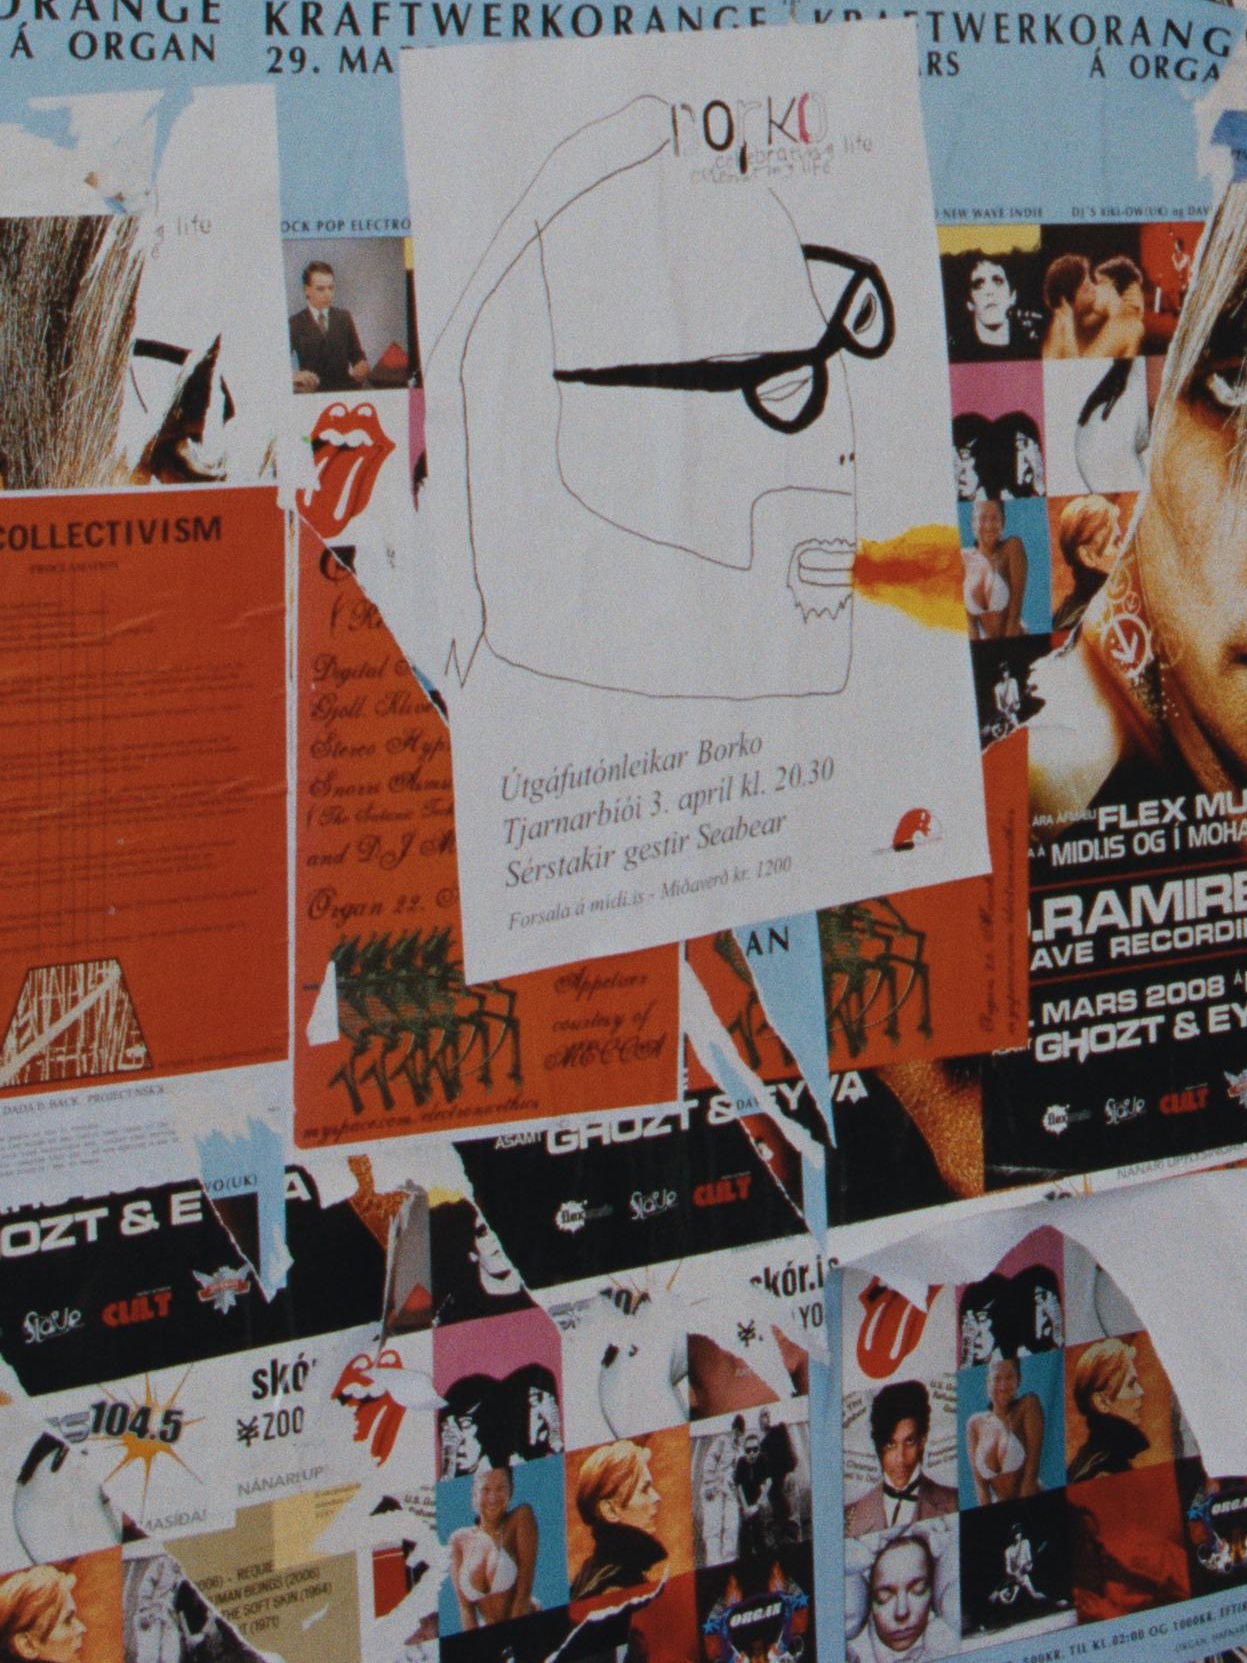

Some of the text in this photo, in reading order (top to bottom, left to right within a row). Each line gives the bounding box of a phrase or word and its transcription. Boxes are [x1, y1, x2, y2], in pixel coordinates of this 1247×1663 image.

[11, 22, 216, 63] Á ORGAN
[267, 46, 318, 74] 29.
[318, 220, 345, 231] POP
[351, 218, 412, 231] ELECTRO
[942, 207, 1044, 219] NEW WAVE INDIE
[500, 731, 763, 804] Útgáfutónleikar Borko
[504, 756, 835, 852] Tjarnarbíói 3. apríl kl. 20.30
[1098, 796, 1187, 831] FLEX
[505, 812, 787, 889] Sérstakir gestir Seabear
[1133, 831, 1166, 855] OG
[1174, 822, 1181, 850] Í
[509, 905, 570, 932] Forsala
[574, 901, 585, 917] á
[733, 865, 750, 884] kr.
[757, 855, 792, 879] 1200
[1042, 989, 1138, 1025] MARS
[1146, 975, 1225, 1008] 2008
[1035, 1014, 1165, 1064] GHOZT
[1173, 1011, 1200, 1039] &
[121, 1201, 159, 1234] &
[102, 1294, 172, 1328] CULT
[90, 1400, 184, 1445] 104.5
[286, 1567, 321, 1588] (2006)
[243, 1599, 270, 1615] SOFT
[272, 1591, 298, 1609] SKIN
[1149, 1624, 1168, 1637] OG
